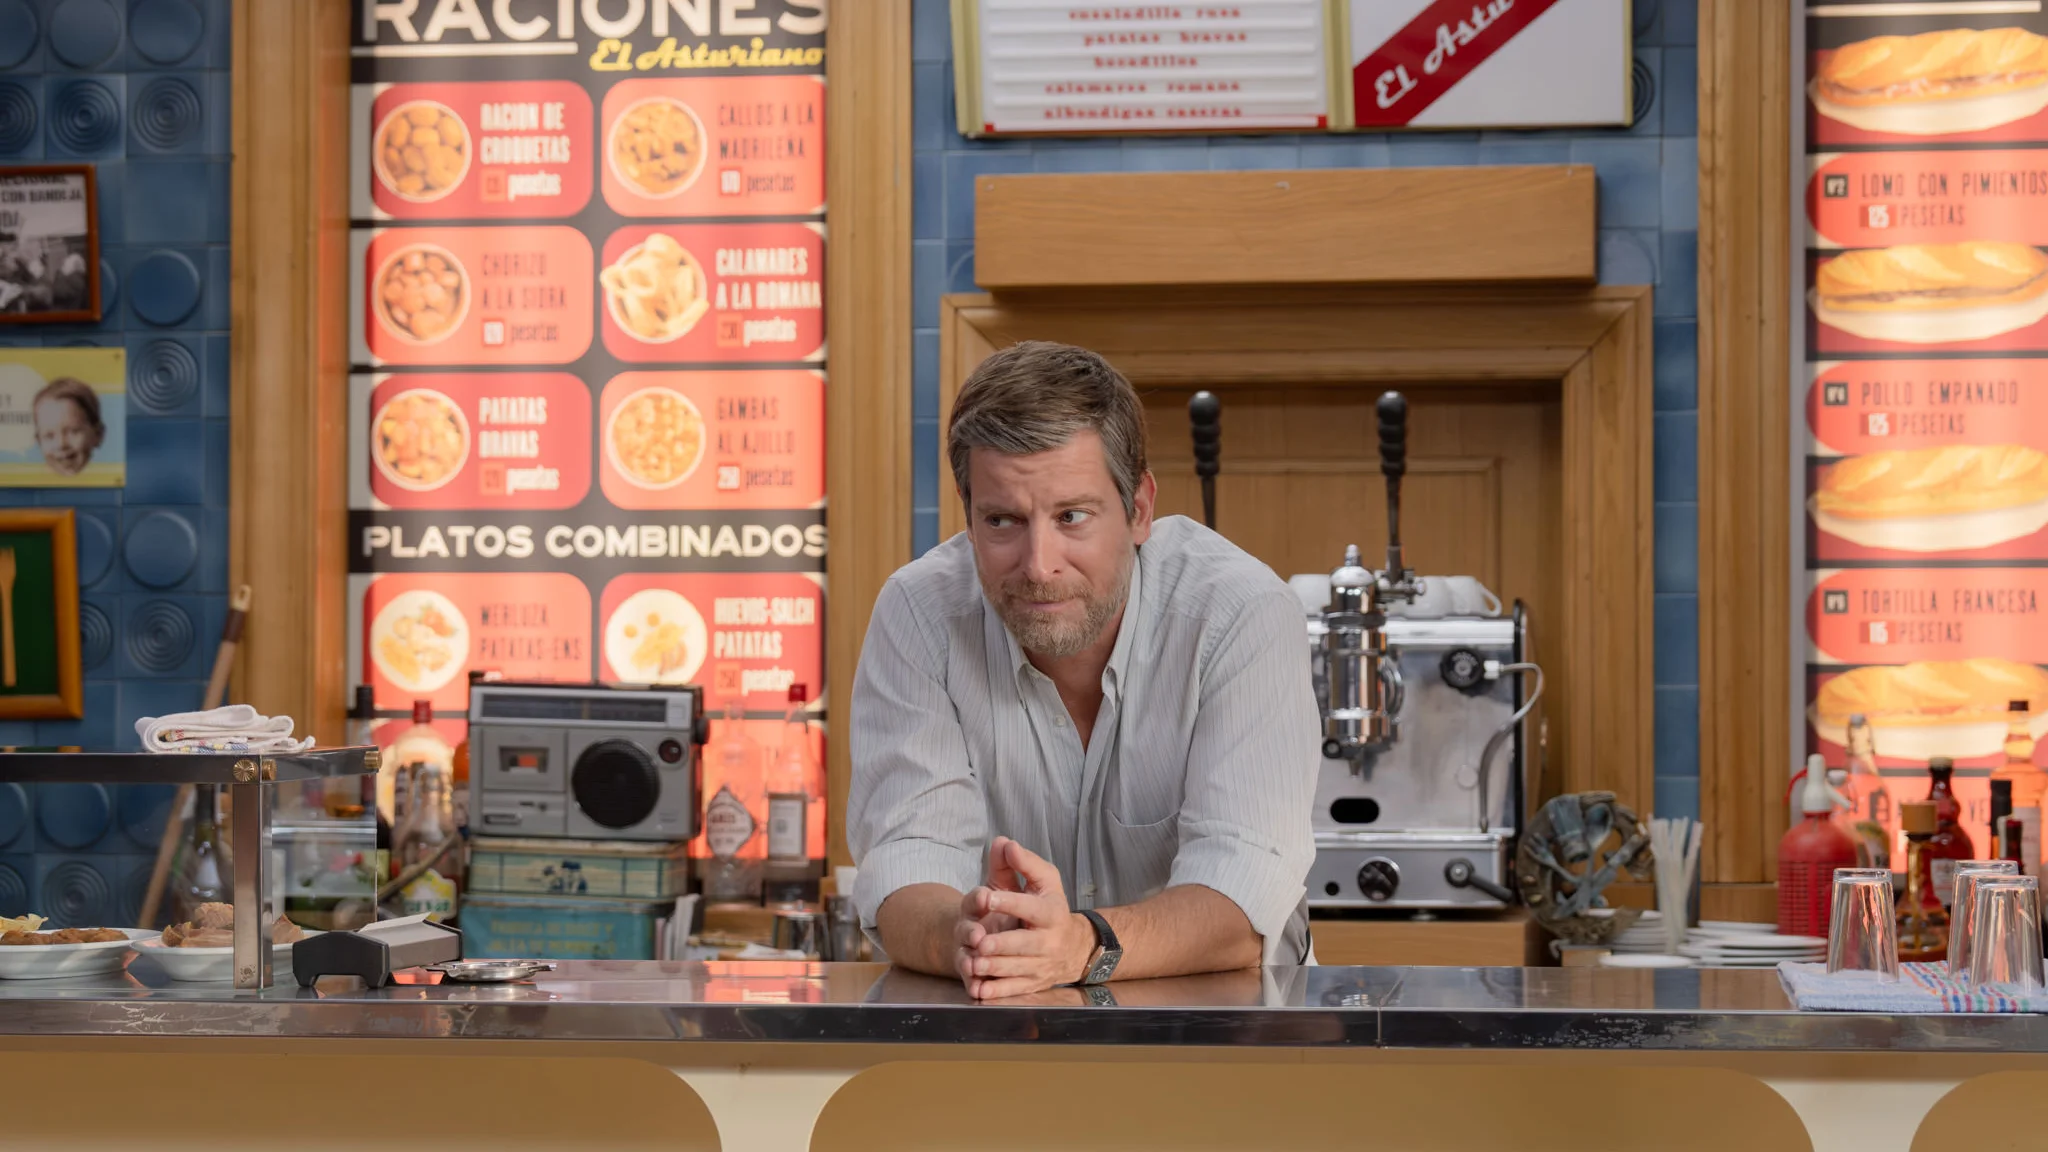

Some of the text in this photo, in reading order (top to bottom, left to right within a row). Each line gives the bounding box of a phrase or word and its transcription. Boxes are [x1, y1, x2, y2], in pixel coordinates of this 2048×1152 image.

[363, 0, 829, 41] RACIONES
[1084, 32, 1161, 47] patatas
[589, 36, 826, 72] El Asturiano
[1374, 63, 1418, 110] El
[719, 102, 816, 127] CALLOS A LA
[1861, 172, 1904, 198] LOMO
[1918, 172, 1948, 197] CON
[1962, 170, 2048, 197] PIMIENTOS
[1901, 204, 1966, 227] PESETAS
[482, 252, 547, 277] CHORIZO
[715, 248, 808, 277] CALAMARES
[482, 287, 490, 311] A
[497, 287, 515, 311] LA
[715, 281, 728, 310] A
[731, 281, 753, 310] LA
[1861, 381, 1912, 406] POLLO
[1929, 380, 2019, 405] EMPANADO
[479, 396, 547, 425] PATATAS
[718, 396, 779, 421] GAMBAS
[1902, 412, 1966, 435] PESETAS
[363, 524, 828, 559] PLATOS COMBINADOS
[1862, 589, 1939, 614] TORTILLA
[1953, 589, 2039, 614] FRANCESA
[481, 603, 550, 628] MERLUZA
[1900, 621, 1963, 643] PESETAS
[714, 630, 783, 660] PATATAS
